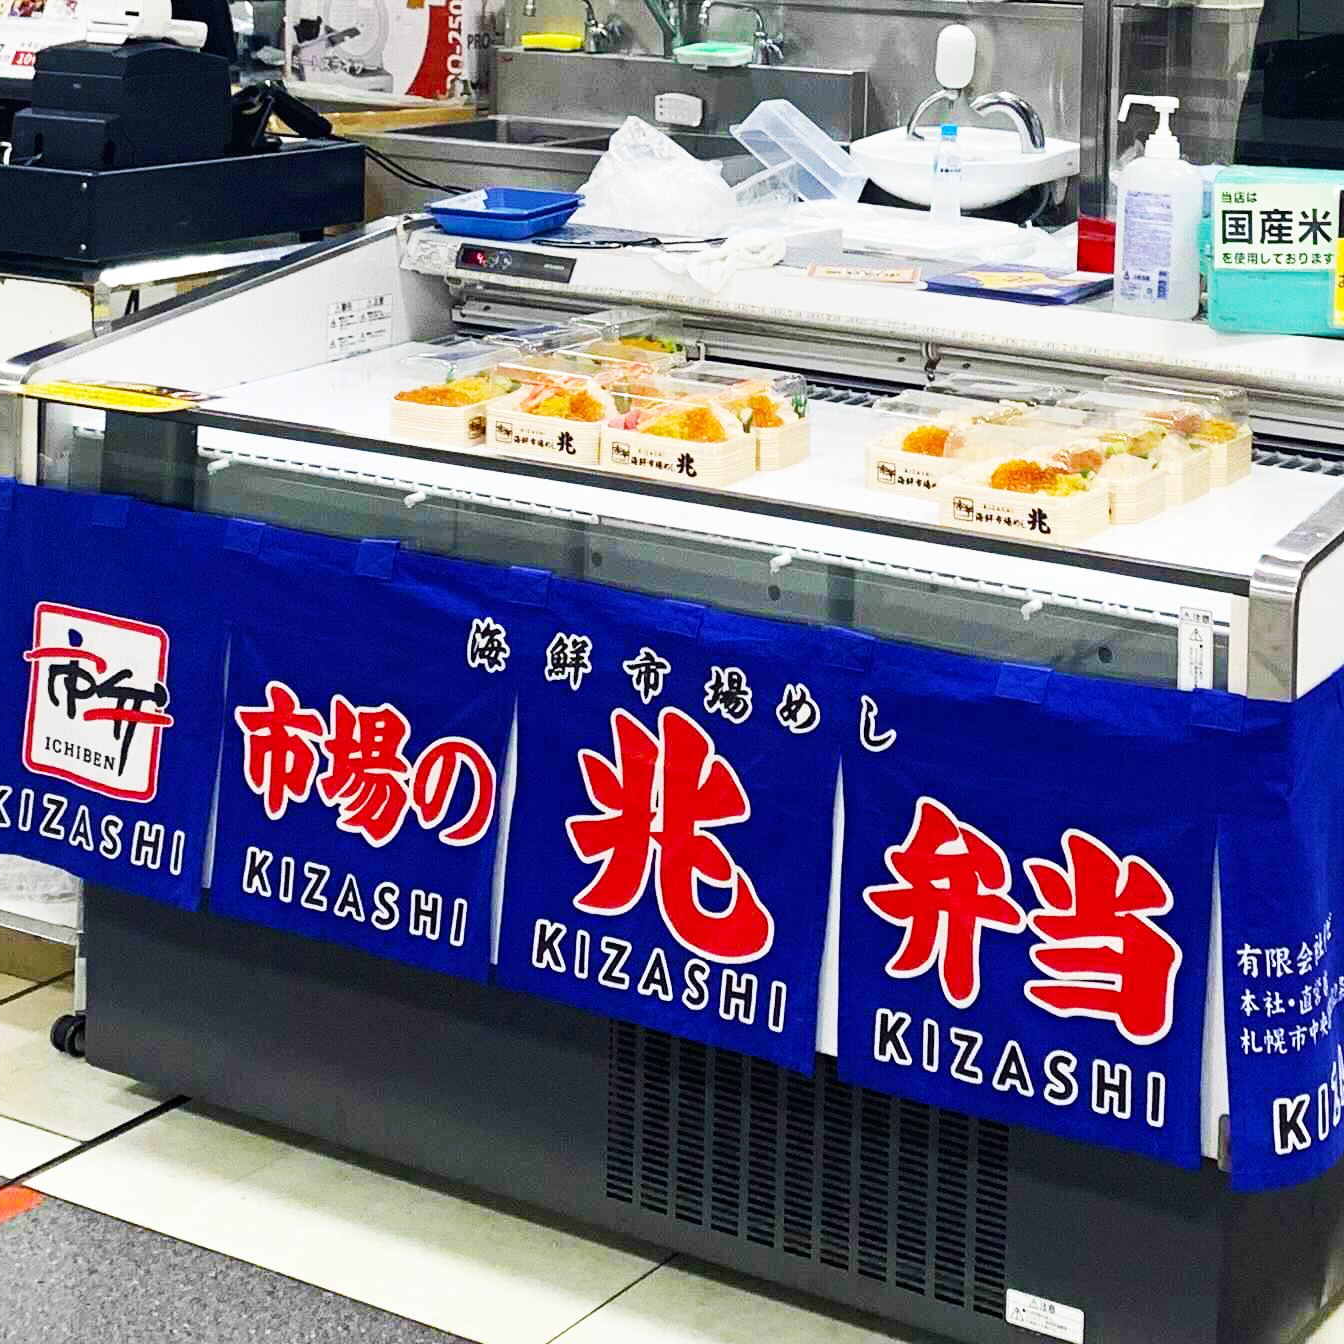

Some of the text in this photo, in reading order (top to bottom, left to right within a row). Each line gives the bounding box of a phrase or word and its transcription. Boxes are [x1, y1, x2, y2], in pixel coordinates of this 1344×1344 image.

[1221, 191, 1258, 205] 当店は
[1221, 208, 1333, 246] 国産米
[1221, 252, 1335, 265] を使用しております
[1027, 507, 1051, 535] 兆
[467, 617, 897, 752] 海鮮市場めし
[44, 736, 116, 772] ICHIBEN
[235, 681, 1183, 1046] 市場の 兆 弁当
[243, 846, 468, 947] KIZASHI
[531, 918, 788, 1034] KIZASHI
[873, 1009, 1167, 1128] KIZASHI
